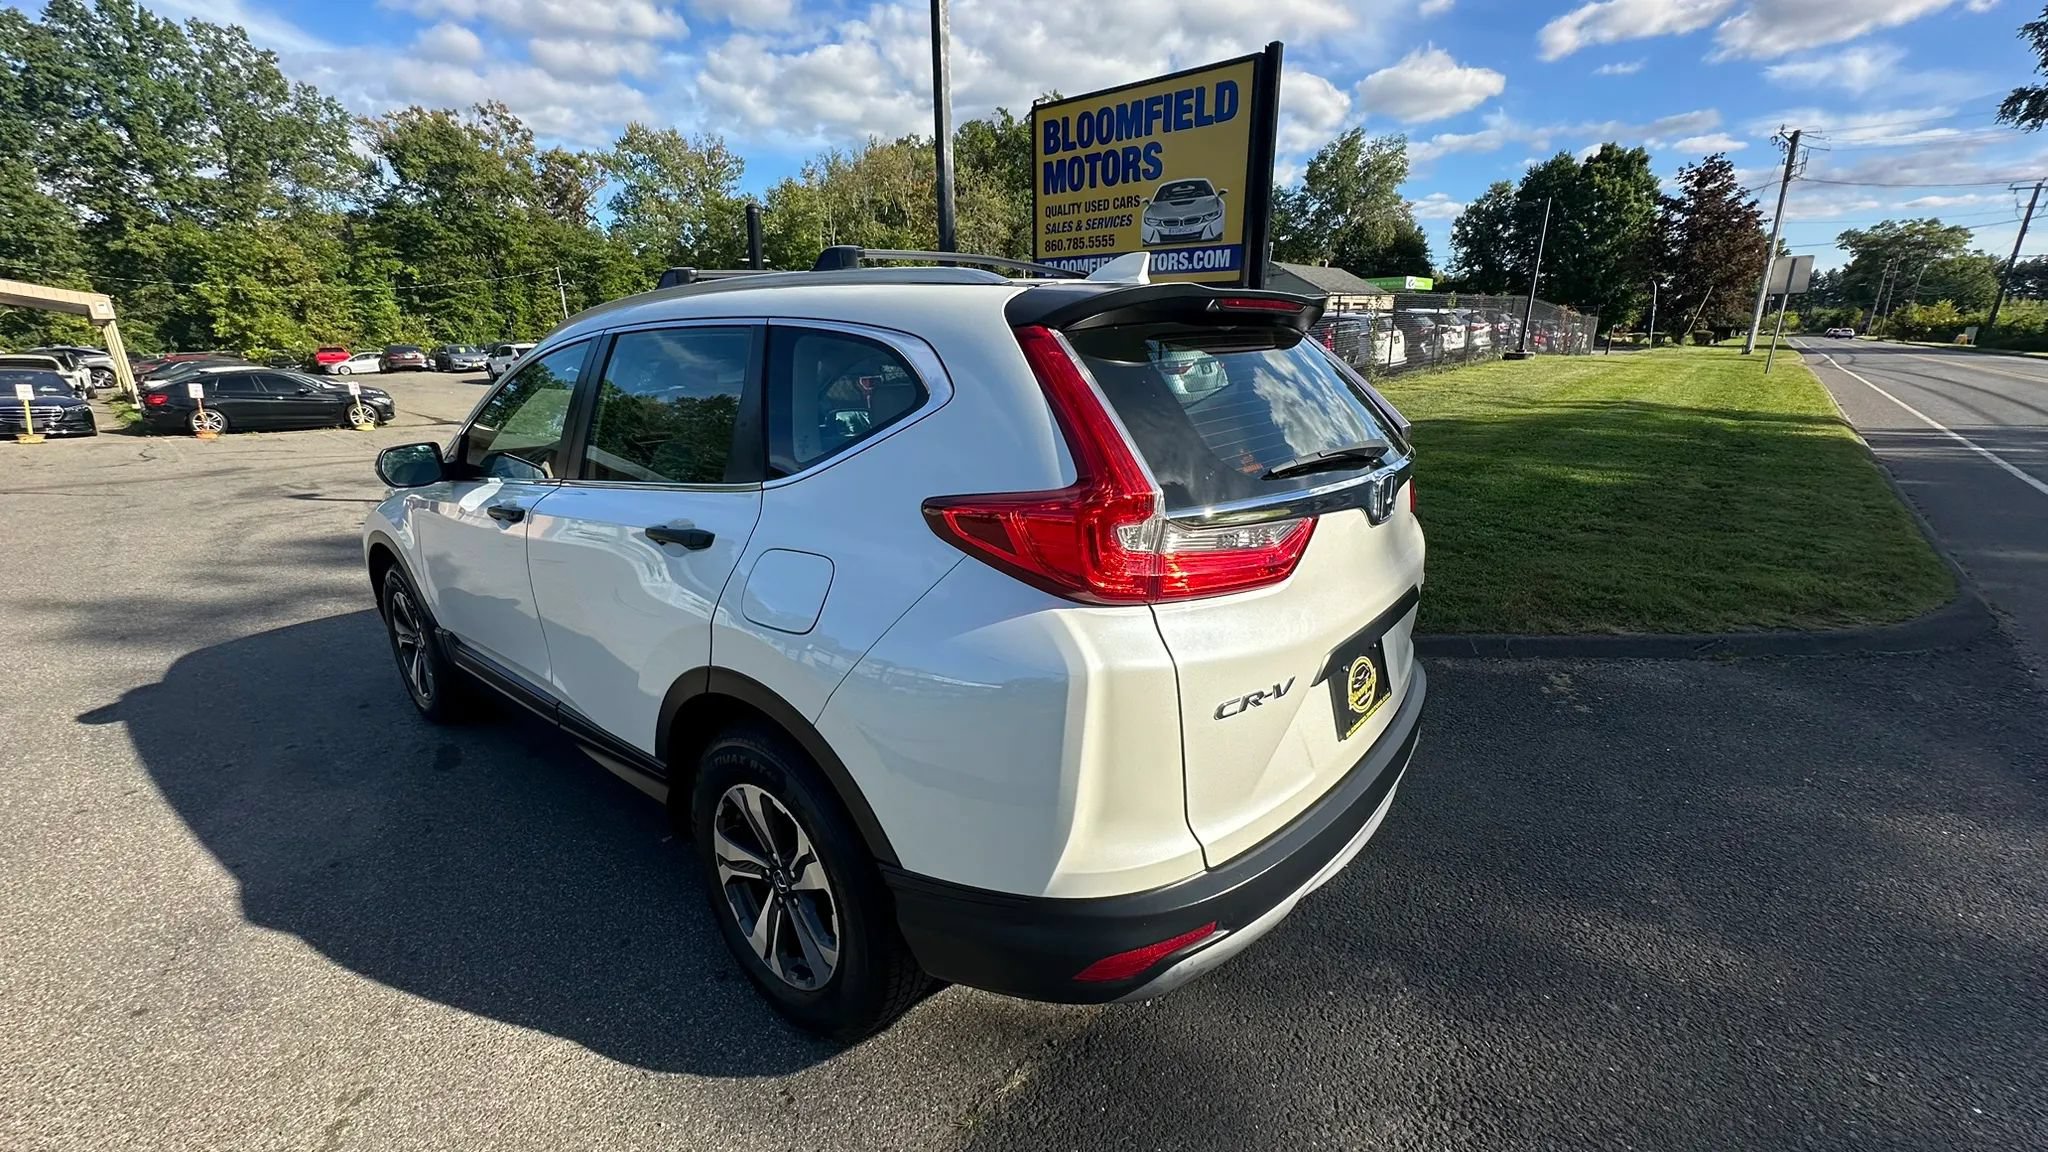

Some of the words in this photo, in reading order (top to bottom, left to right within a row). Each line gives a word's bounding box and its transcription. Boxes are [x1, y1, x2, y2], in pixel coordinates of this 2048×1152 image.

[1043, 79, 1239, 156] BLOOMFIELD
[1043, 141, 1164, 196] MOTORS
[1045, 202, 1082, 219] QUALITY
[1084, 199, 1110, 213] USED
[1113, 194, 1140, 210] CARS
[1045, 220, 1073, 235] SALES
[1075, 219, 1083, 231] &
[1085, 214, 1133, 230] SERVICES
[1044, 234, 1115, 253] 860.785.5555
[1213, 675, 1296, 720] CR-V
